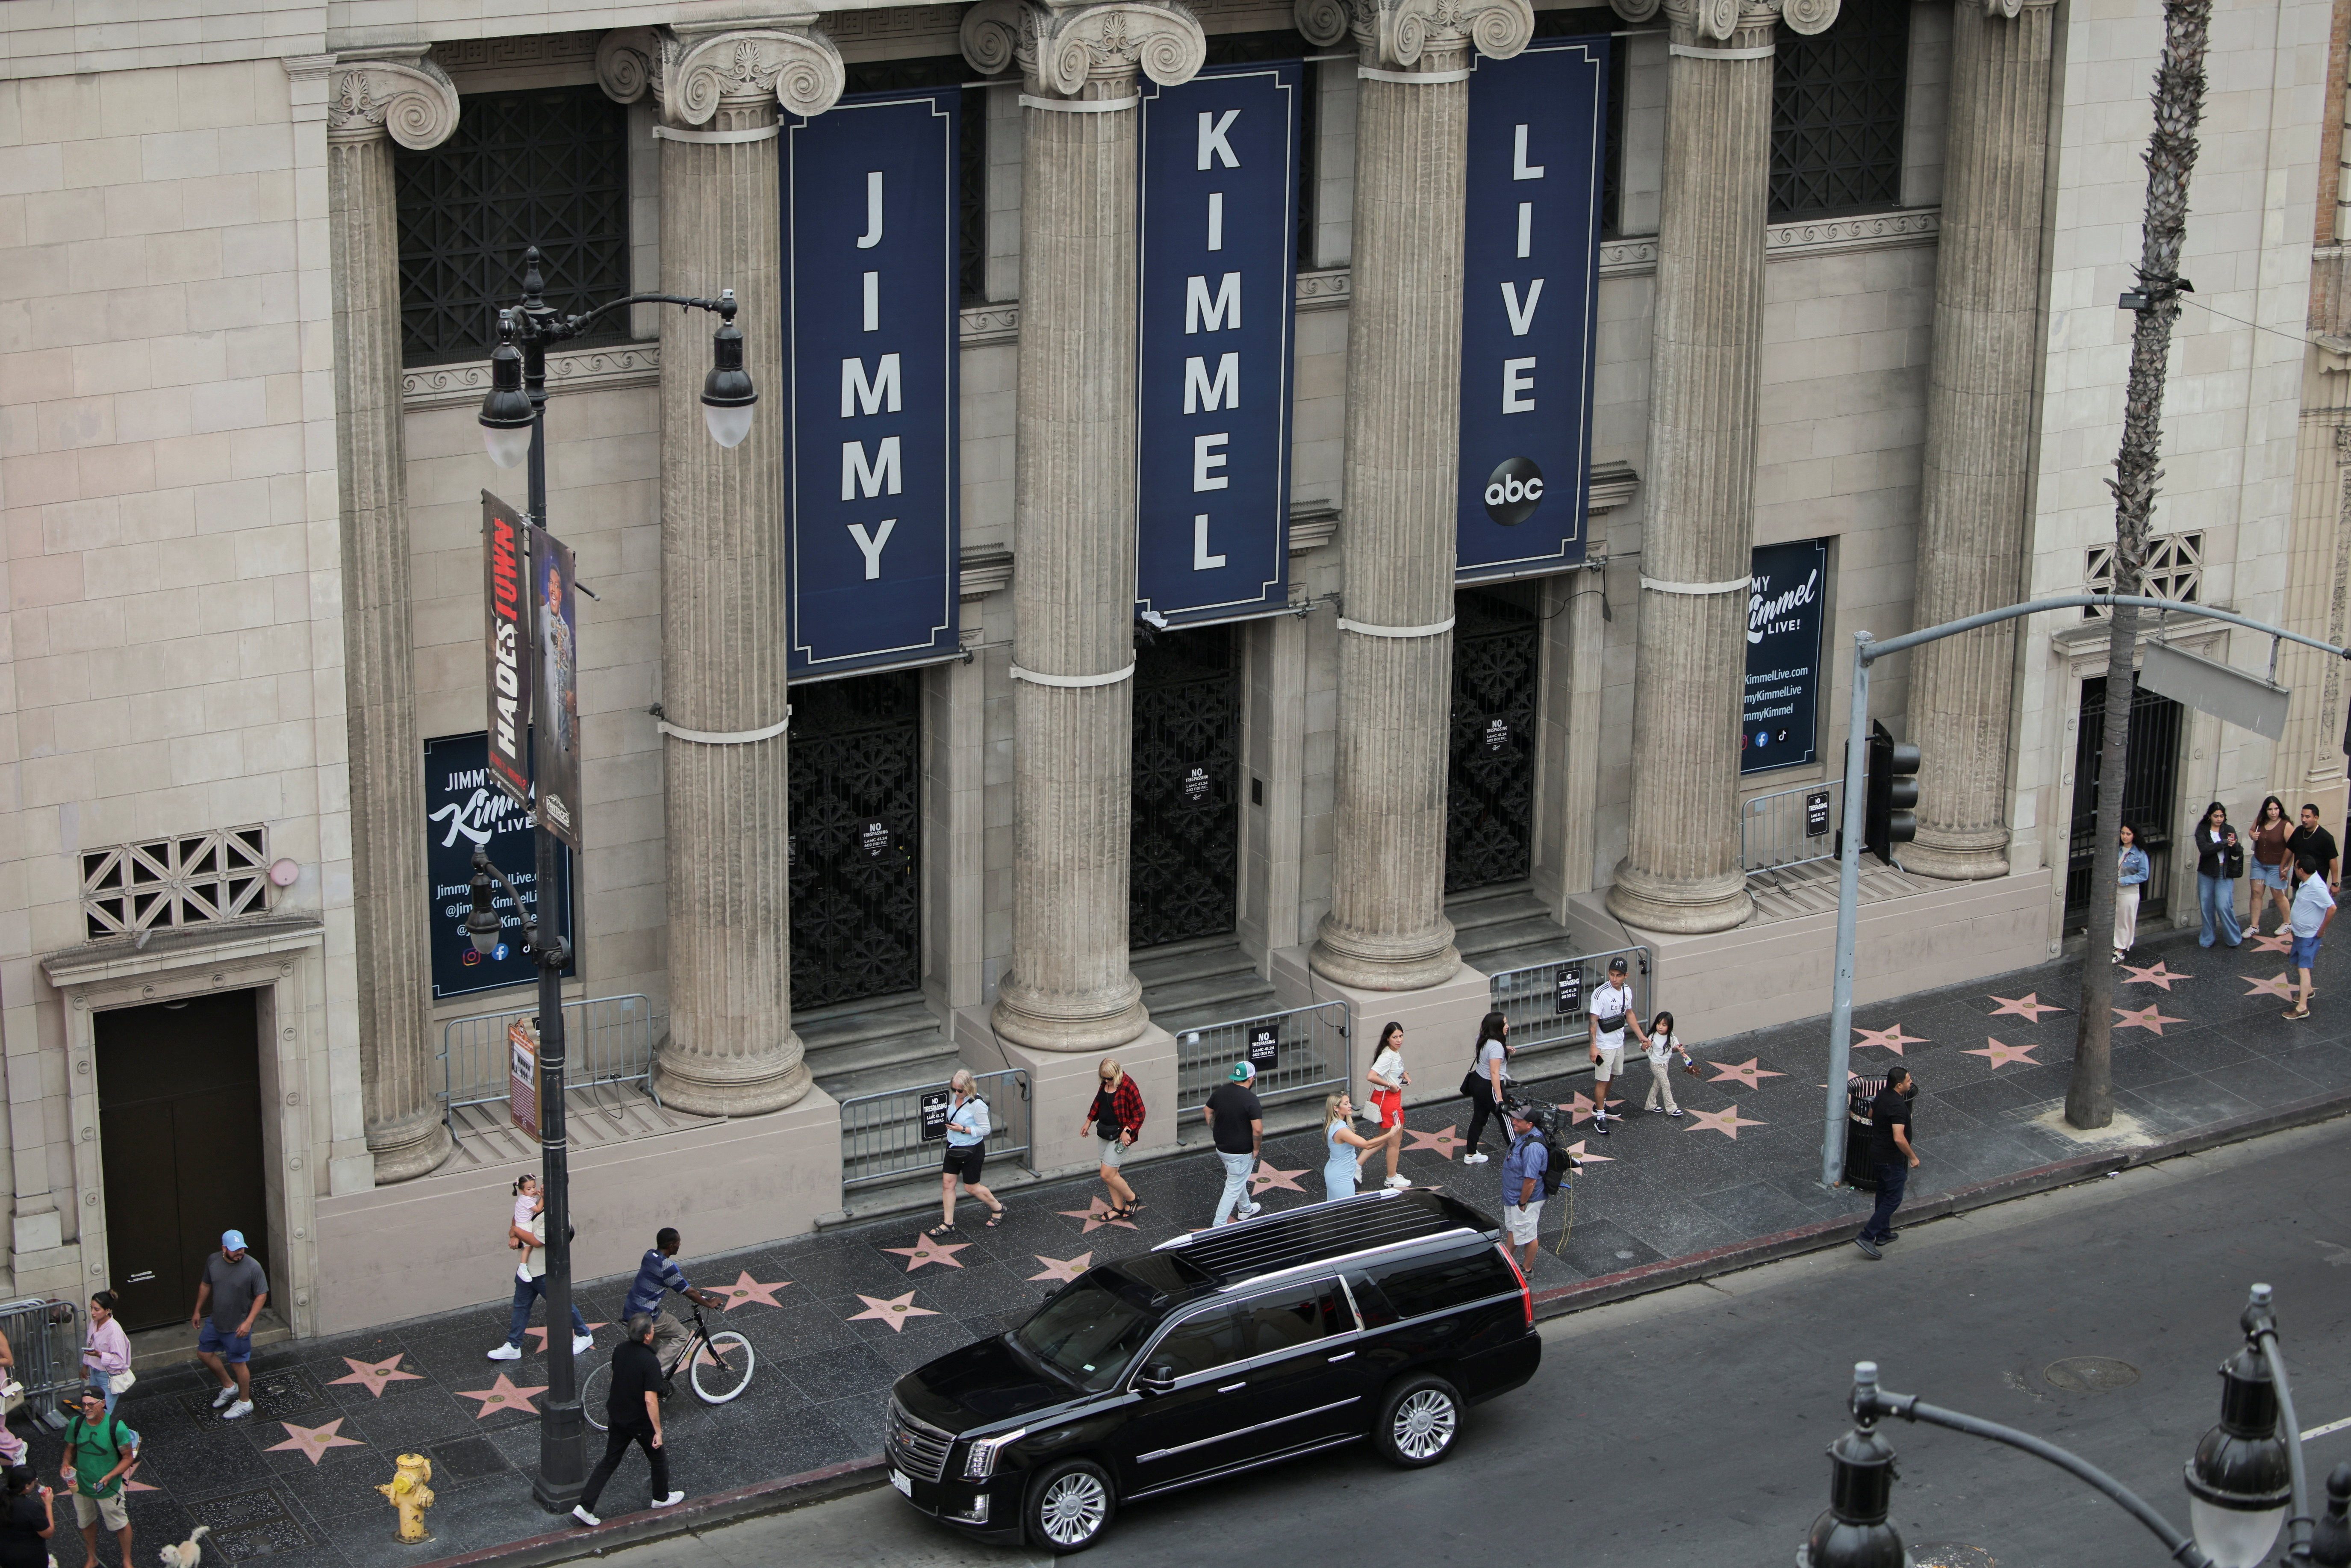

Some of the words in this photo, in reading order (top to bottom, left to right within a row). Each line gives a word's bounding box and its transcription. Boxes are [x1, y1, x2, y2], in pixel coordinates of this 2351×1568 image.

[1501, 124, 1544, 414] LIVE
[1184, 110, 1240, 570] KIMMEL
[842, 171, 902, 579] JIMMY
[1485, 474, 1543, 505] abc
[1768, 619, 1800, 634] LIVE!
[1492, 719, 1502, 728] NO
[1192, 768, 1202, 777] NO
[547, 798, 569, 824] PANTAGES
[1809, 802, 1827, 811] TRESPASSING
[869, 822, 881, 832] NO
[863, 829, 888, 837] TRESPASSING
[1559, 978, 1579, 987] TRESPASSING
[1258, 1032, 1270, 1041] NO
[924, 1102, 947, 1113] TRESPASSING
[875, 1303, 888, 1312] LYLES
